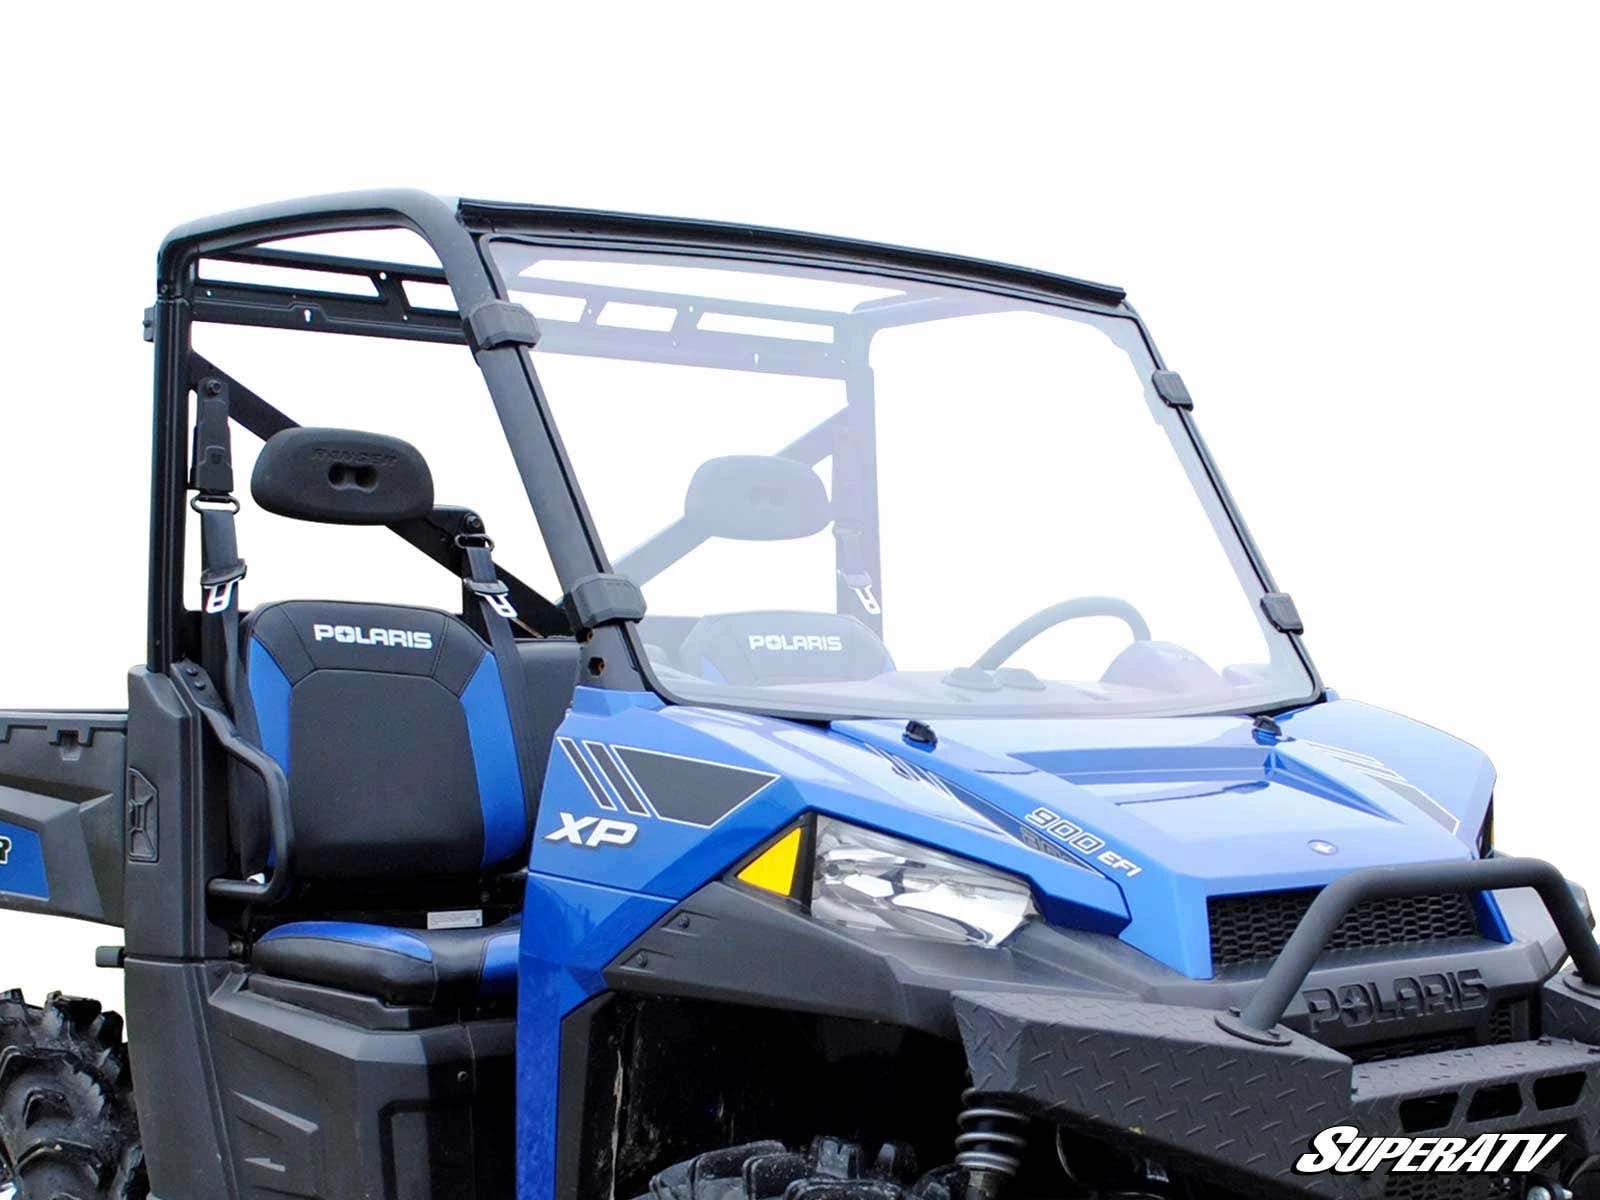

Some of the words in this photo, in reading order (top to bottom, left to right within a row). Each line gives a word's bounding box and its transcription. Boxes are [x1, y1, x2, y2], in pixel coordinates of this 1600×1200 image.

[313, 624, 433, 649] POLARIS
[749, 634, 843, 651] POLARIS
[544, 811, 638, 847] XP
[1024, 806, 1106, 855] 900
[1096, 850, 1143, 878] EFI
[1302, 968, 1490, 1033] POLARIS
